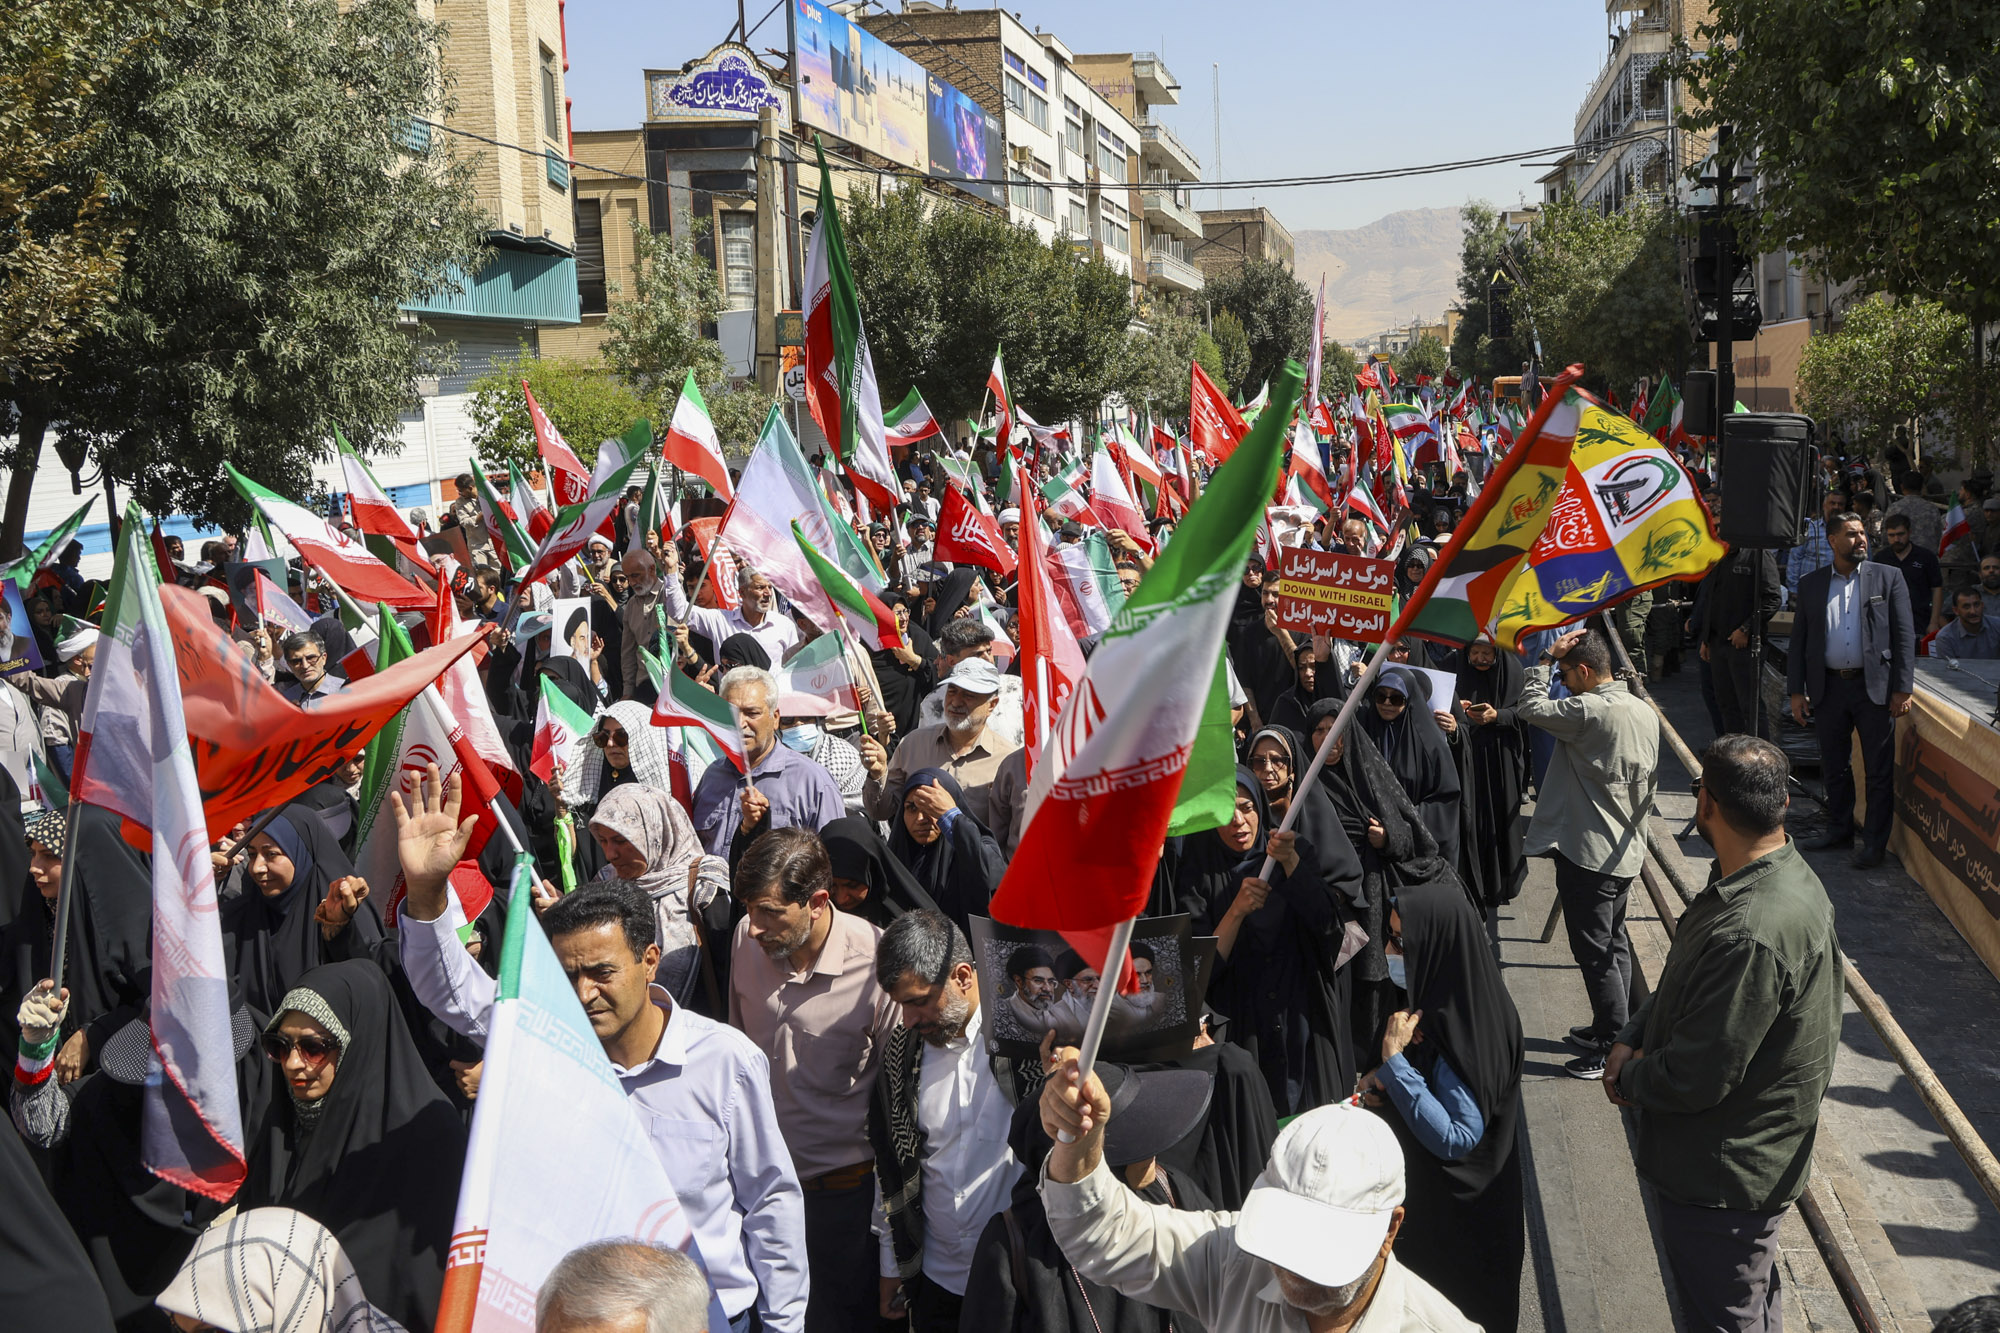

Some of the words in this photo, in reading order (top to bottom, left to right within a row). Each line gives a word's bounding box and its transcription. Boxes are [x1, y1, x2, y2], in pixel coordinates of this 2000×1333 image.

[928, 76, 943, 98] Gplus
[788, 371, 806, 387] تل
[1284, 554, 1338, 581] اسرائیل
[1335, 567, 1353, 585] بر
[1356, 564, 1389, 590] مرگ
[1283, 583, 1316, 597] DOWN
[1319, 589, 1346, 602] WITH
[1349, 593, 1386, 607] ISRAEL
[1282, 601, 1338, 627] لاسرائیل
[1340, 613, 1385, 634] الموت
[1917, 803, 1932, 834] بیت
[1931, 811, 1950, 844] اهل
[1948, 838, 1967, 861] حرم
